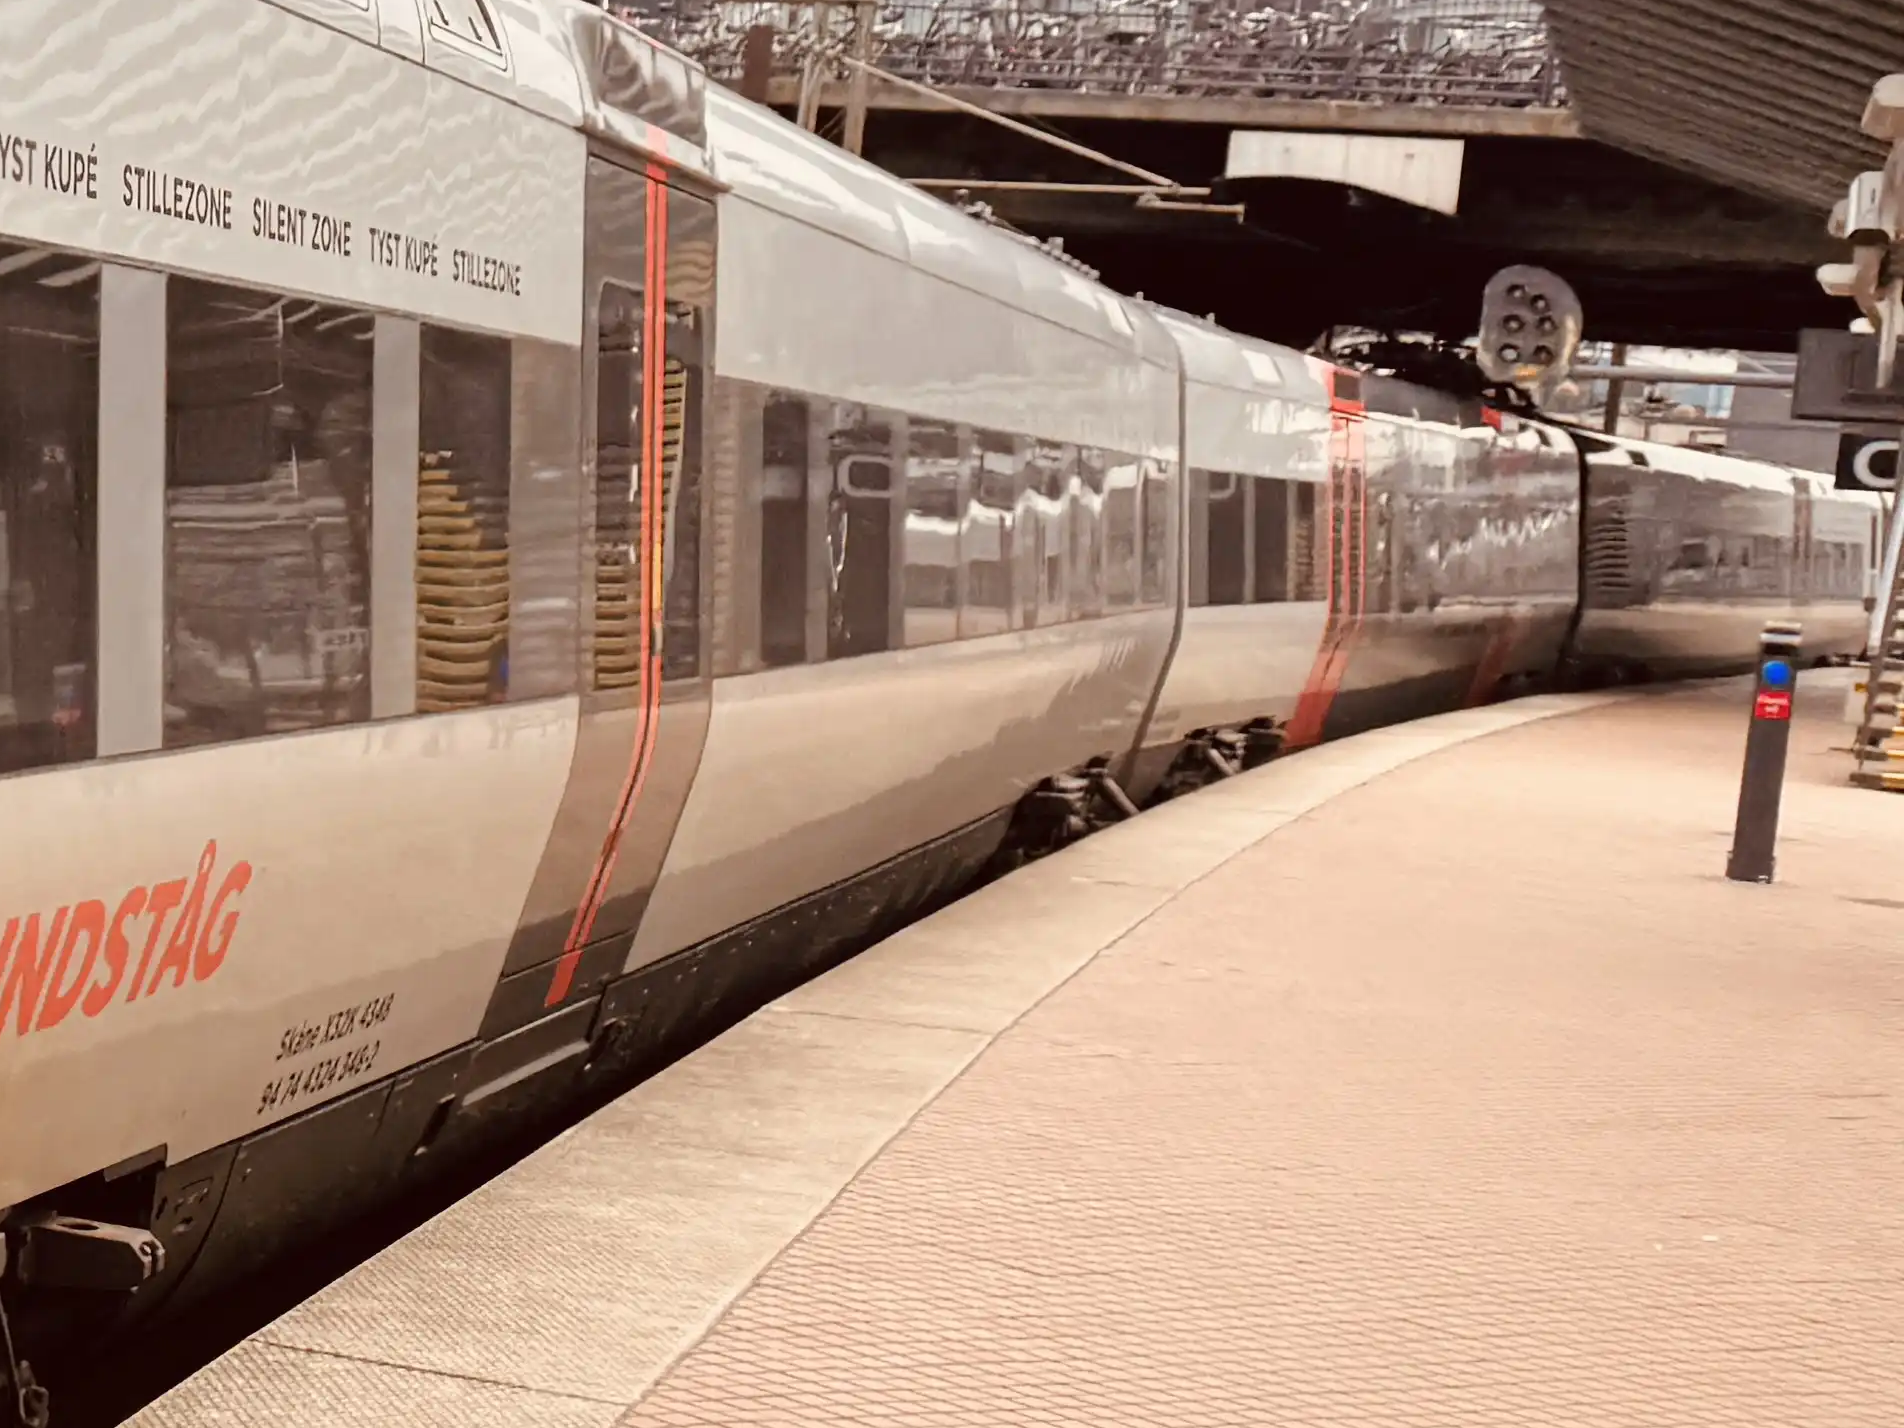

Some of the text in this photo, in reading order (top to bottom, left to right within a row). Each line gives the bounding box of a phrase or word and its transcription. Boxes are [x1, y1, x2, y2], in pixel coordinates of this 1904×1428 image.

[44, 142, 98, 199] KUPÉ
[123, 164, 232, 229] STILLEZONE
[253, 197, 307, 247] SILENT
[311, 212, 351, 257] ZONE
[369, 227, 402, 268] TYST
[405, 234, 438, 277] KUPÉ
[452, 248, 522, 297] STILLEZONE
[360, 992, 395, 1029] 4348
[256, 1076, 283, 1115] 94
